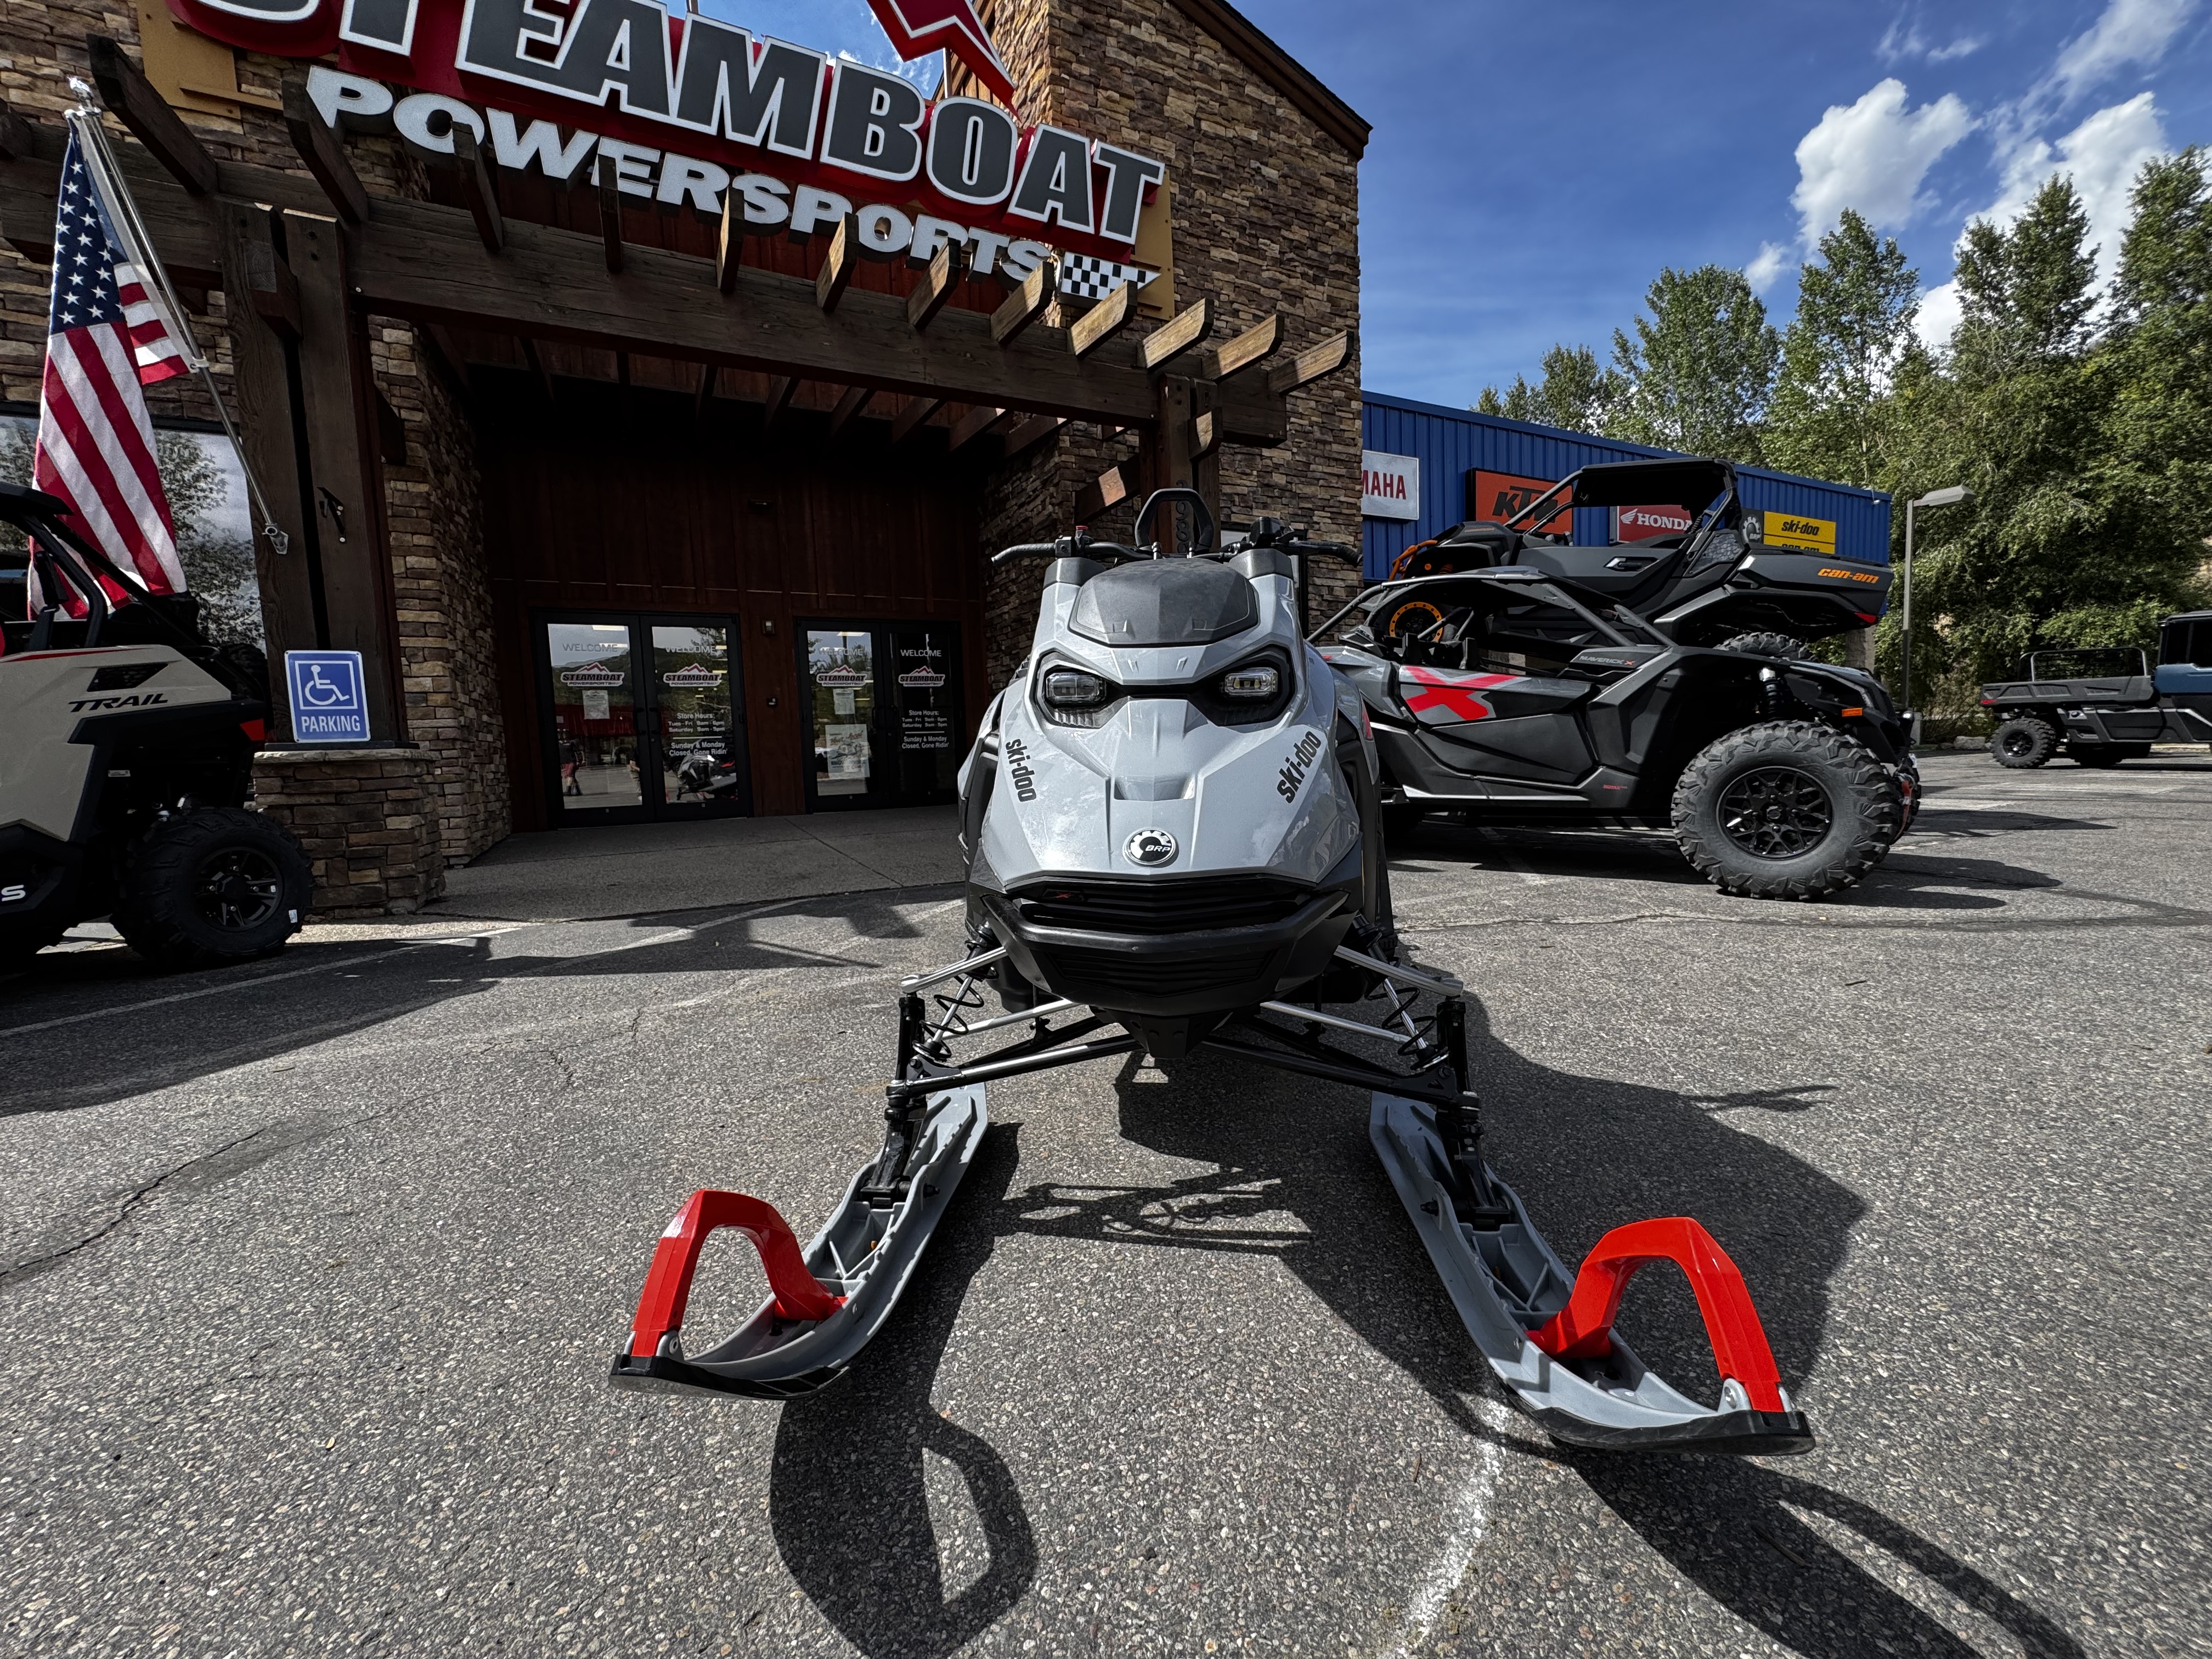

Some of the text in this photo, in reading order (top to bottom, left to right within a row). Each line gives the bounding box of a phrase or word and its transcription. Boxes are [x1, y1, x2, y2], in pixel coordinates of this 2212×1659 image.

[211, 0, 1165, 245] EAMBOAT
[306, 65, 1051, 281] POWERSPORTS
[1362, 469, 1407, 500] MAHA
[1492, 485, 1558, 523] KTM
[1781, 520, 1820, 536] ski-doo
[1818, 568, 1879, 584] can-am
[562, 643, 618, 652] WELCOME
[1579, 656, 1625, 664] MAVERICK
[562, 673, 623, 681] STEAMBOAT
[68, 692, 168, 713] TRAIL
[301, 715, 361, 733] PARKING
[1006, 738, 1037, 802] ski-doo
[1277, 731, 1322, 804] ski-doo
